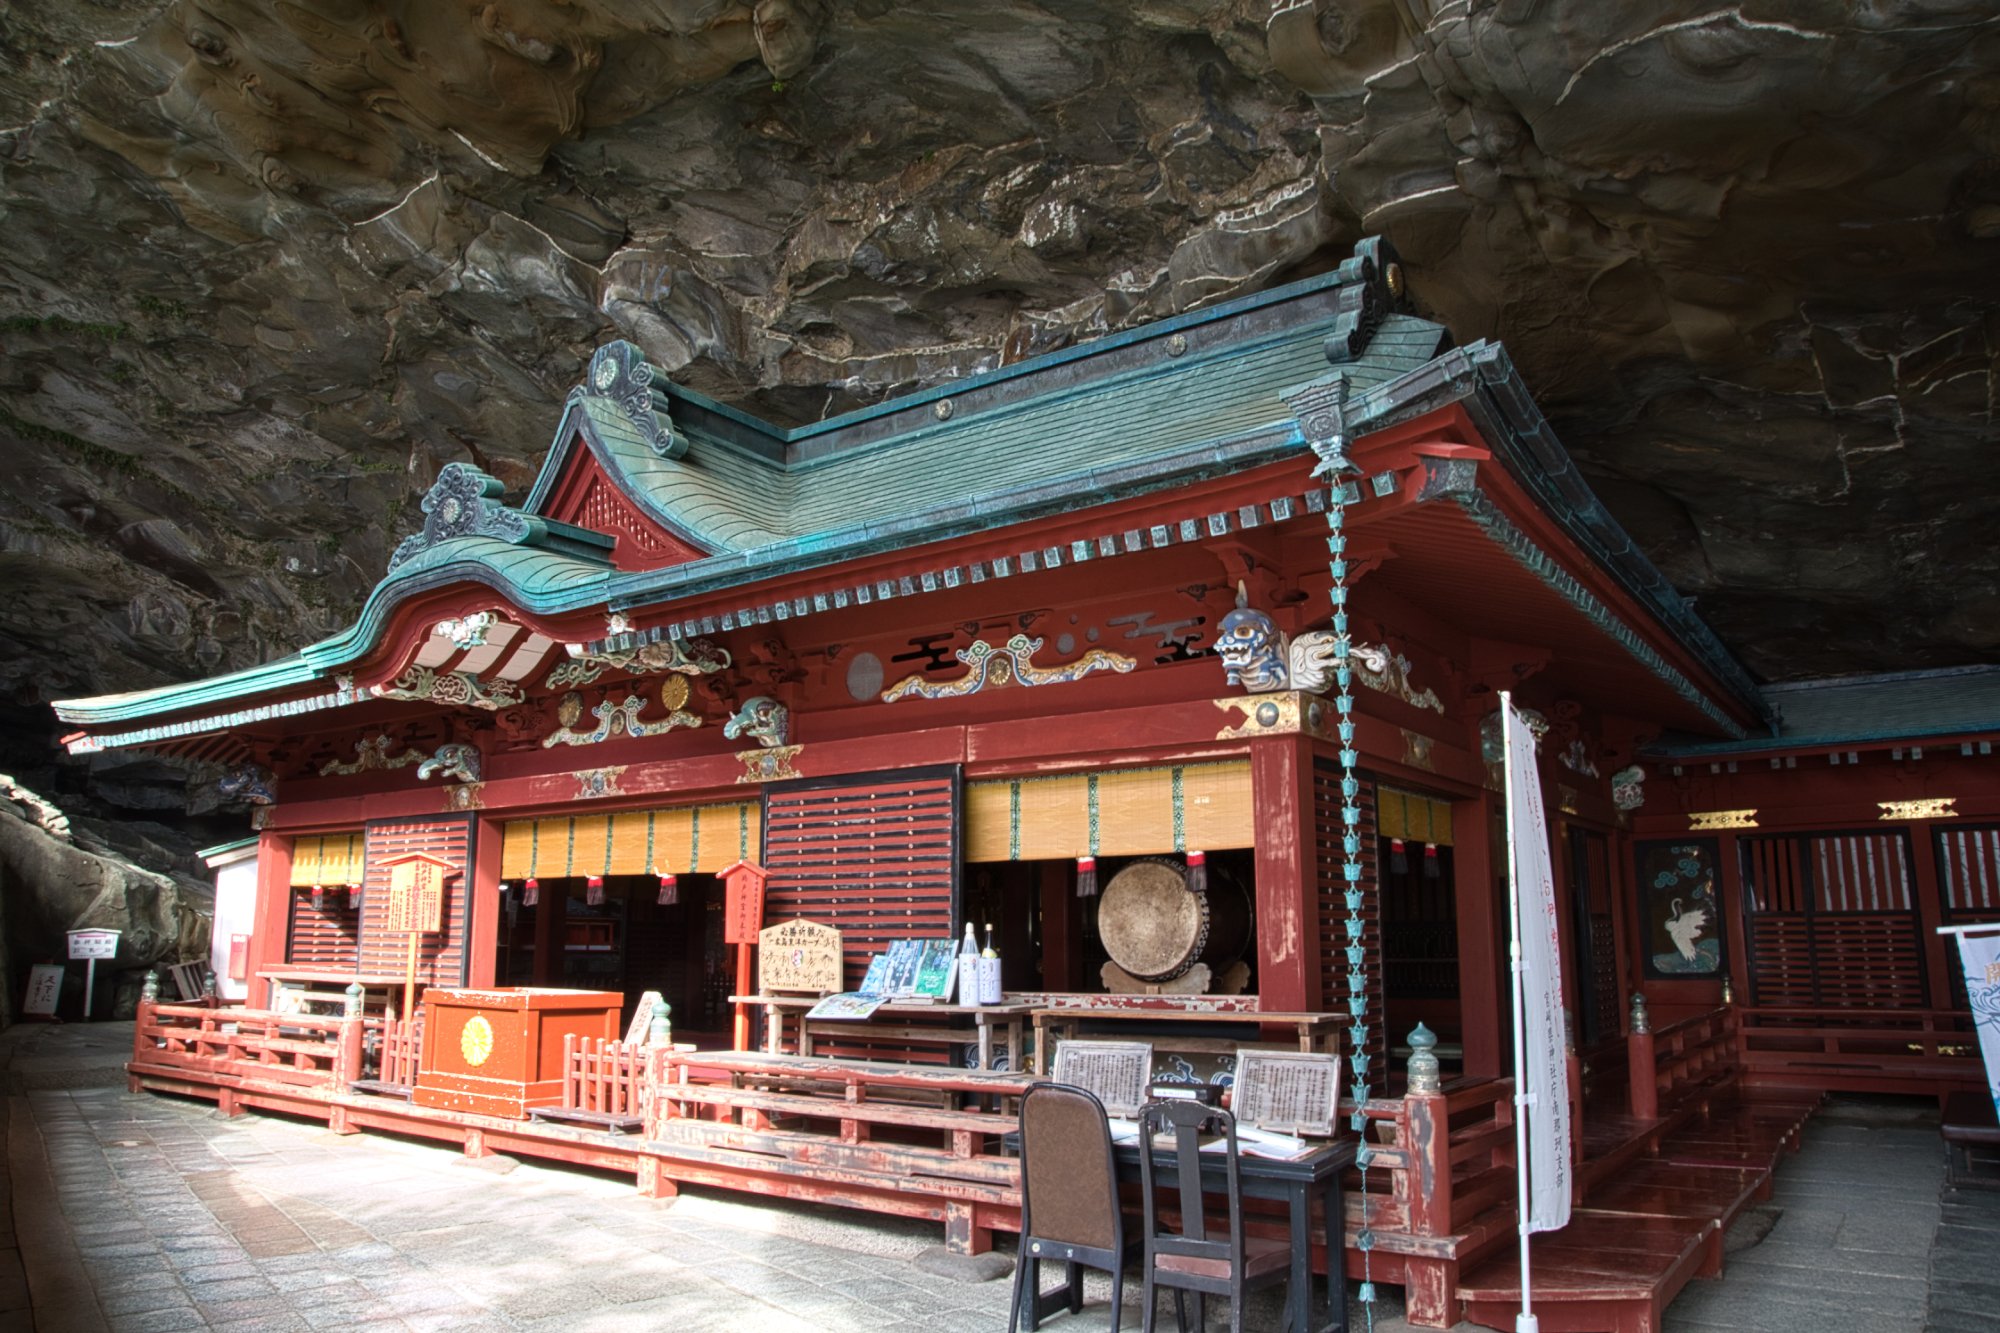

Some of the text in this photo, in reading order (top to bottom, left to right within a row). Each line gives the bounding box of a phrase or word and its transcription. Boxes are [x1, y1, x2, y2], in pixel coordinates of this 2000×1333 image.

[780, 925, 815, 937] 必勝祈願
[775, 937, 820, 947] 広島東洋カープ
